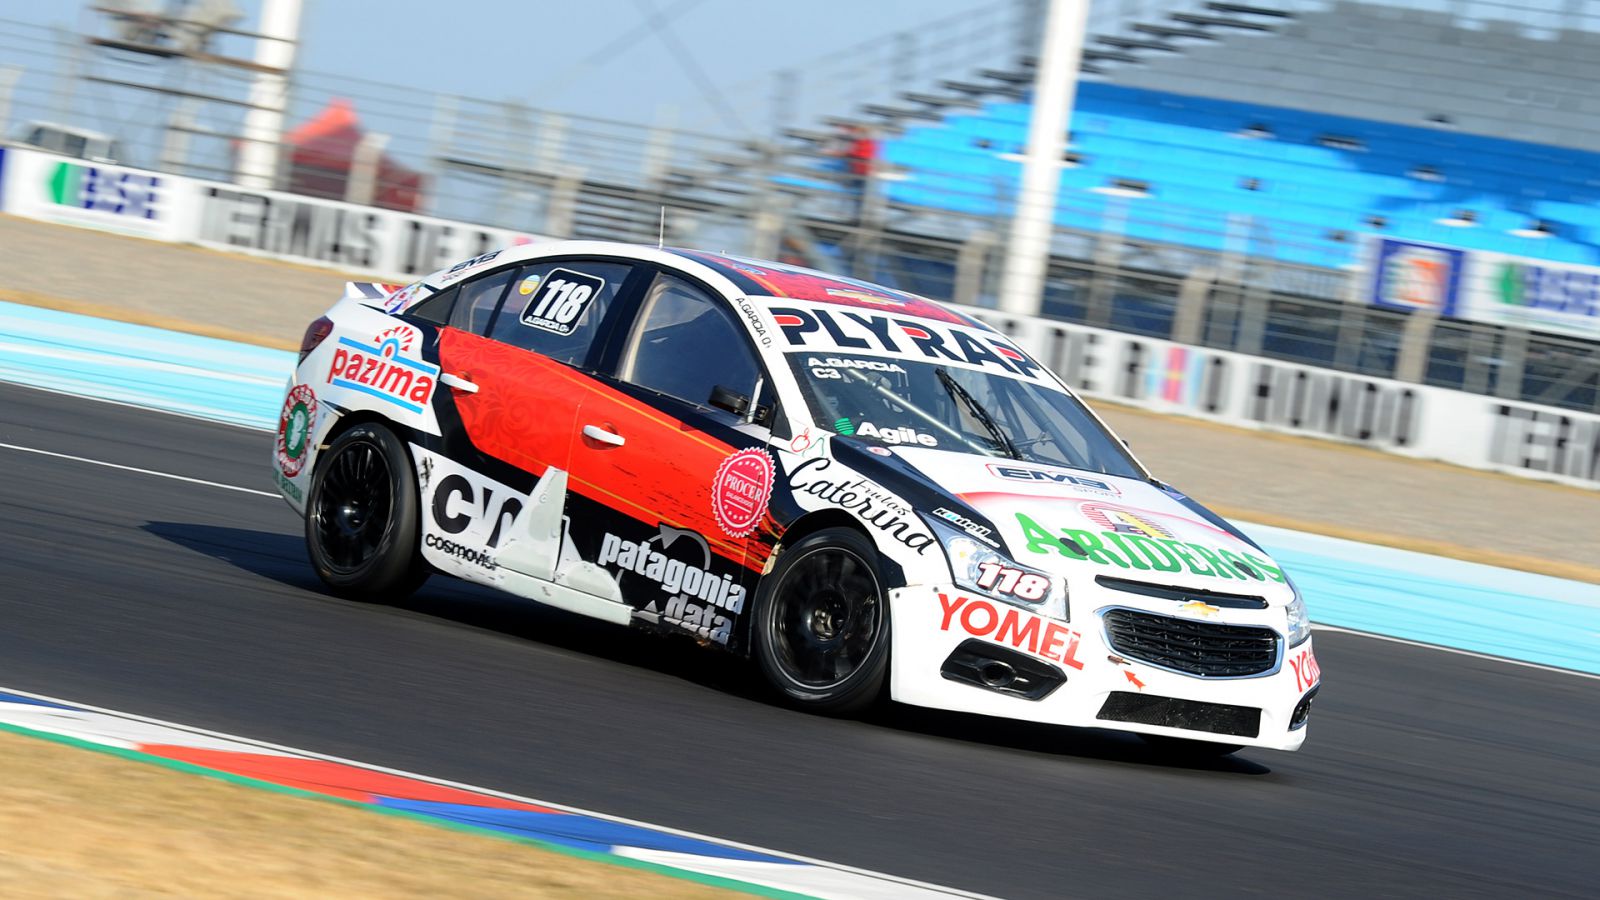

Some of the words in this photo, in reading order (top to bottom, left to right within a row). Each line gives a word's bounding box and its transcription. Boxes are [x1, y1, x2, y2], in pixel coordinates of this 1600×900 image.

[200, 186, 380, 272] TERMAS
[533, 278, 593, 324] 118
[327, 347, 434, 406] pazima
[808, 357, 908, 374] A.GARCIA
[856, 421, 938, 447] Agile
[724, 473, 763, 503] PROCER
[788, 457, 936, 556] Caterina
[850, 474, 914, 517] Frutas
[599, 531, 747, 616] patagonia
[976, 562, 1051, 602] 118
[664, 594, 733, 646] data
[937, 593, 1085, 671] YOMEL
